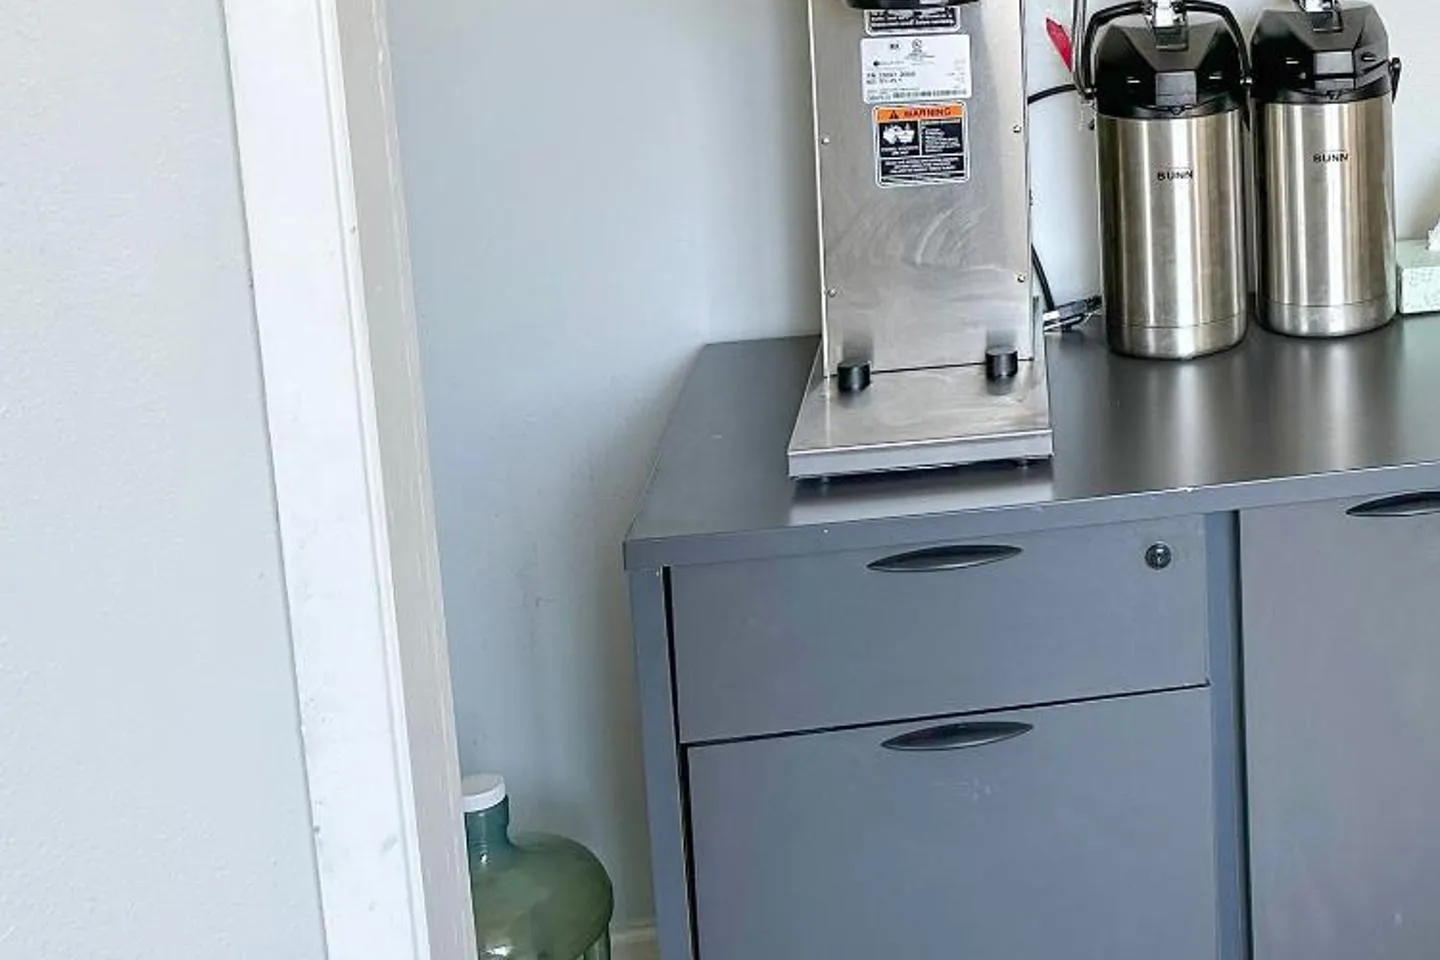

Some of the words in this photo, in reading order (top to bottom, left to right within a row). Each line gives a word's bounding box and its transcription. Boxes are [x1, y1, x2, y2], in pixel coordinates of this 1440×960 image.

[903, 107, 952, 118] WARNING
[1312, 152, 1349, 163] BUNN
[1156, 170, 1194, 181] BUNN
